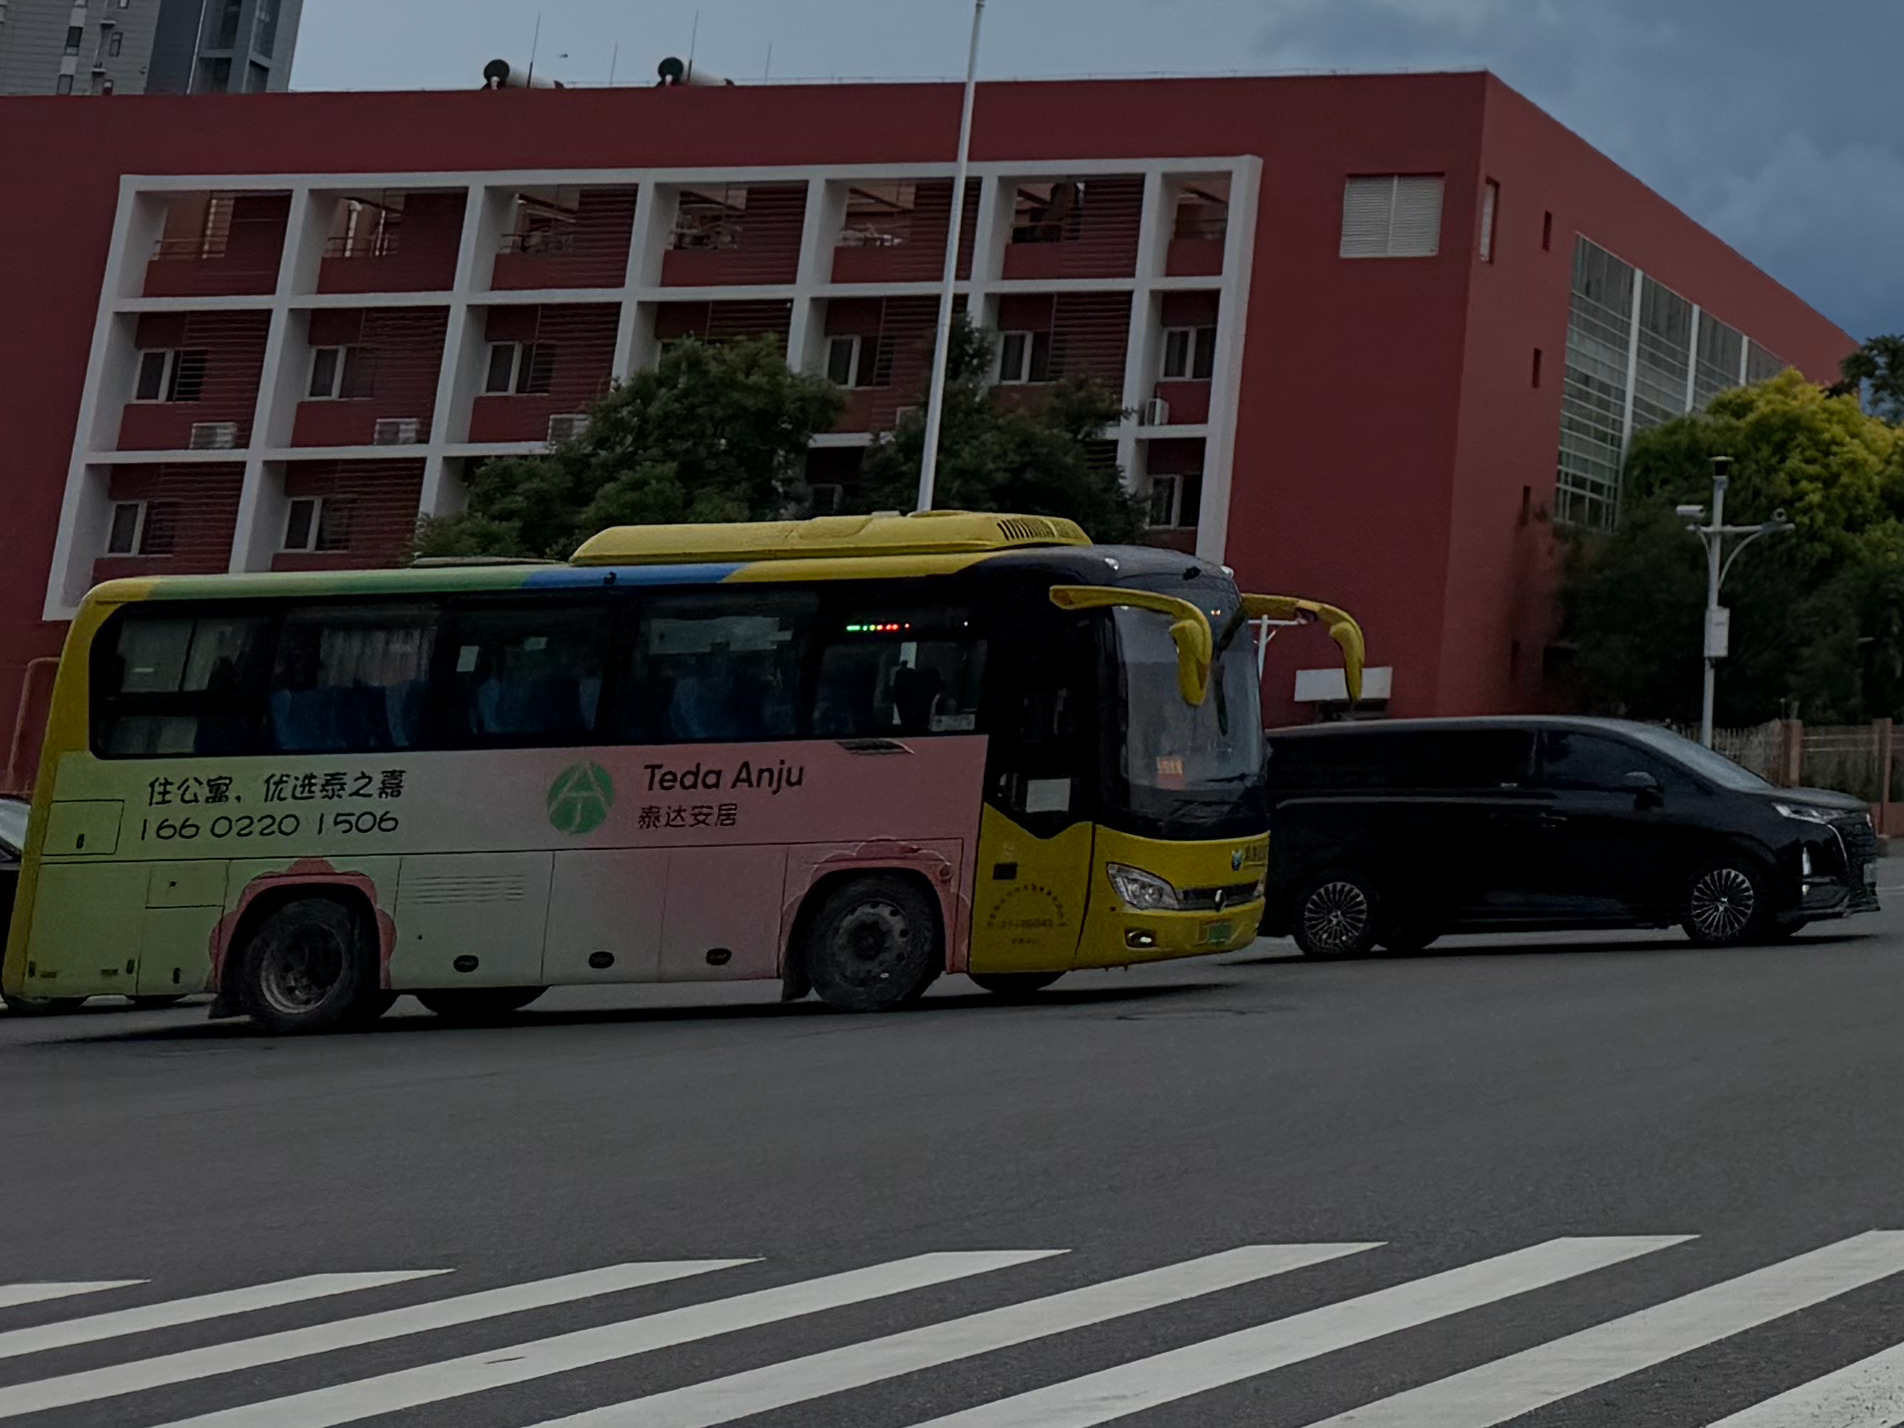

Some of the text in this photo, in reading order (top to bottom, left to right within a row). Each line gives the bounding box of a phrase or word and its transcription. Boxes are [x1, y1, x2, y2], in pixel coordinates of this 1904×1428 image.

[644, 759, 804, 795] Teda Anju
[140, 810, 399, 841] 166 0220 1506
[637, 802, 738, 829] 泰达安居
